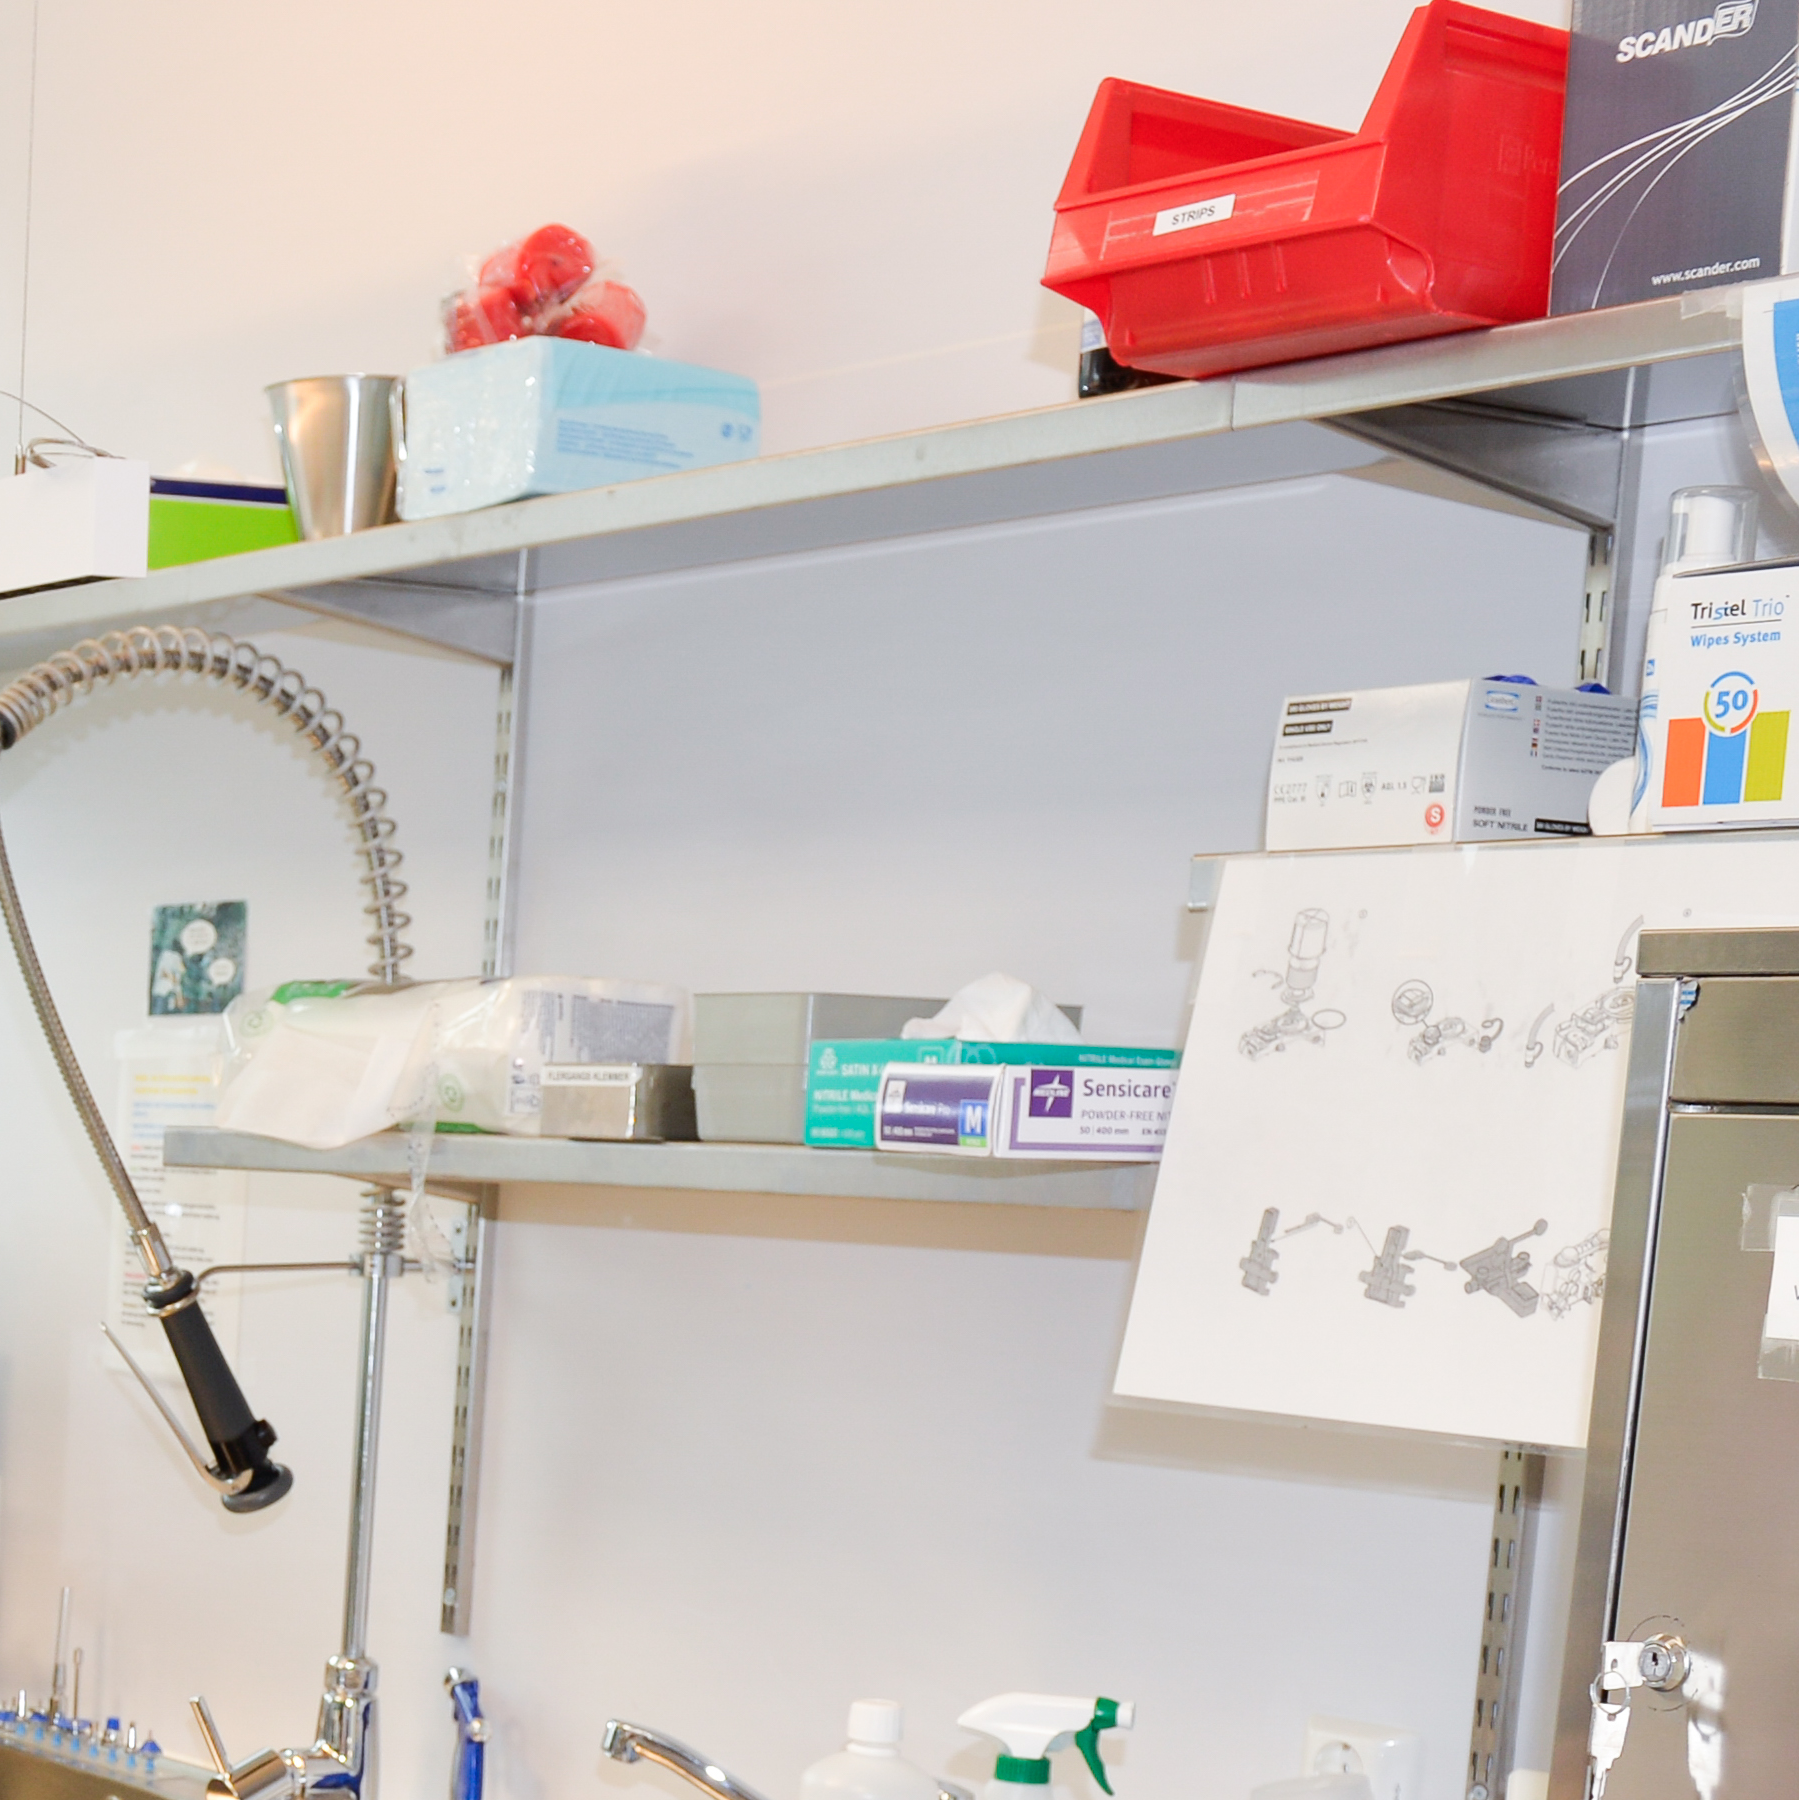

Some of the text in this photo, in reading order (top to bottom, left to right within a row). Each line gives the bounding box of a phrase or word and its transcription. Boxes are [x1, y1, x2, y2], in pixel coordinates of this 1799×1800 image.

[1615, 3, 1753, 63] SCANDER
[1171, 205, 1215, 225] STRIPS
[1651, 257, 1760, 285] www.scander.com
[1691, 599, 1747, 620] Tristel
[1691, 631, 1781, 649] Wipes System
[1715, 690, 1749, 719] 50
[1429, 808, 1442, 823] S
[1083, 1079, 1172, 1099] Sensicare
[966, 1105, 982, 1135] M
